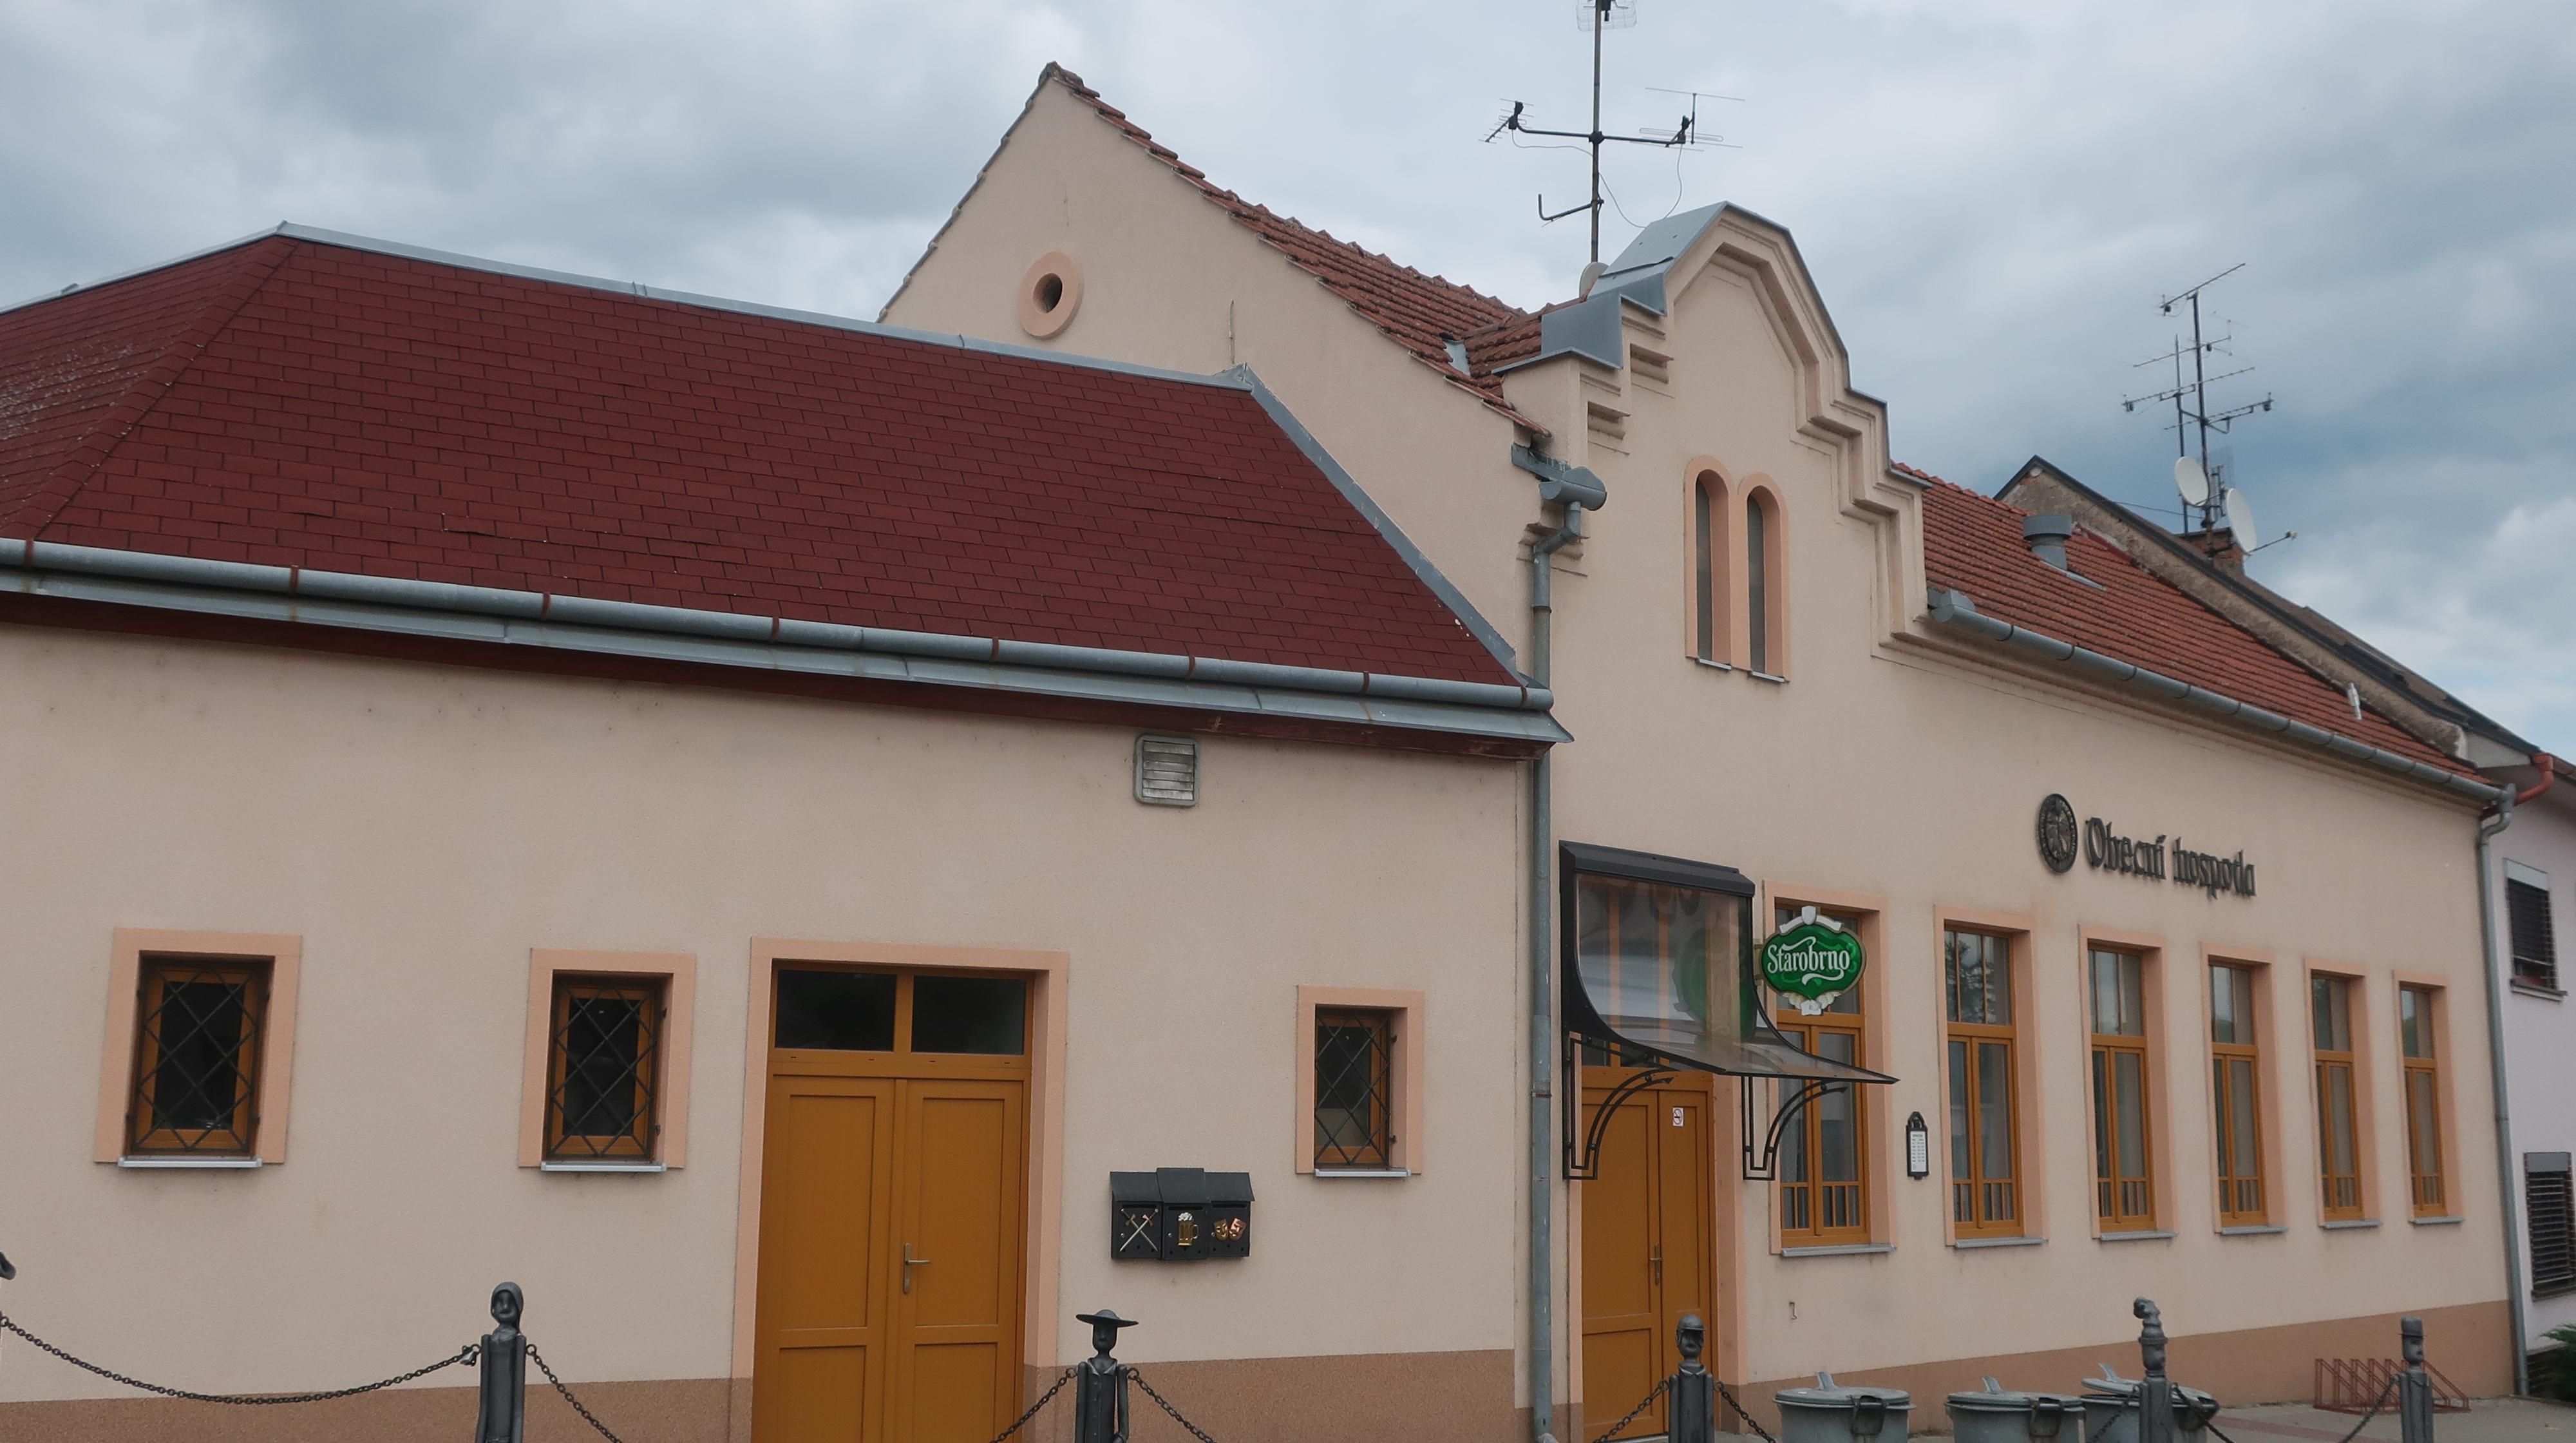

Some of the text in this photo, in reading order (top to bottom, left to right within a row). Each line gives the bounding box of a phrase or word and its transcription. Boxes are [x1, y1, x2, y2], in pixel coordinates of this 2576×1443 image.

[2085, 817, 2166, 880] Obecní
[2173, 837, 2257, 899] hospoda
[1767, 936, 1850, 986] Starobrno
